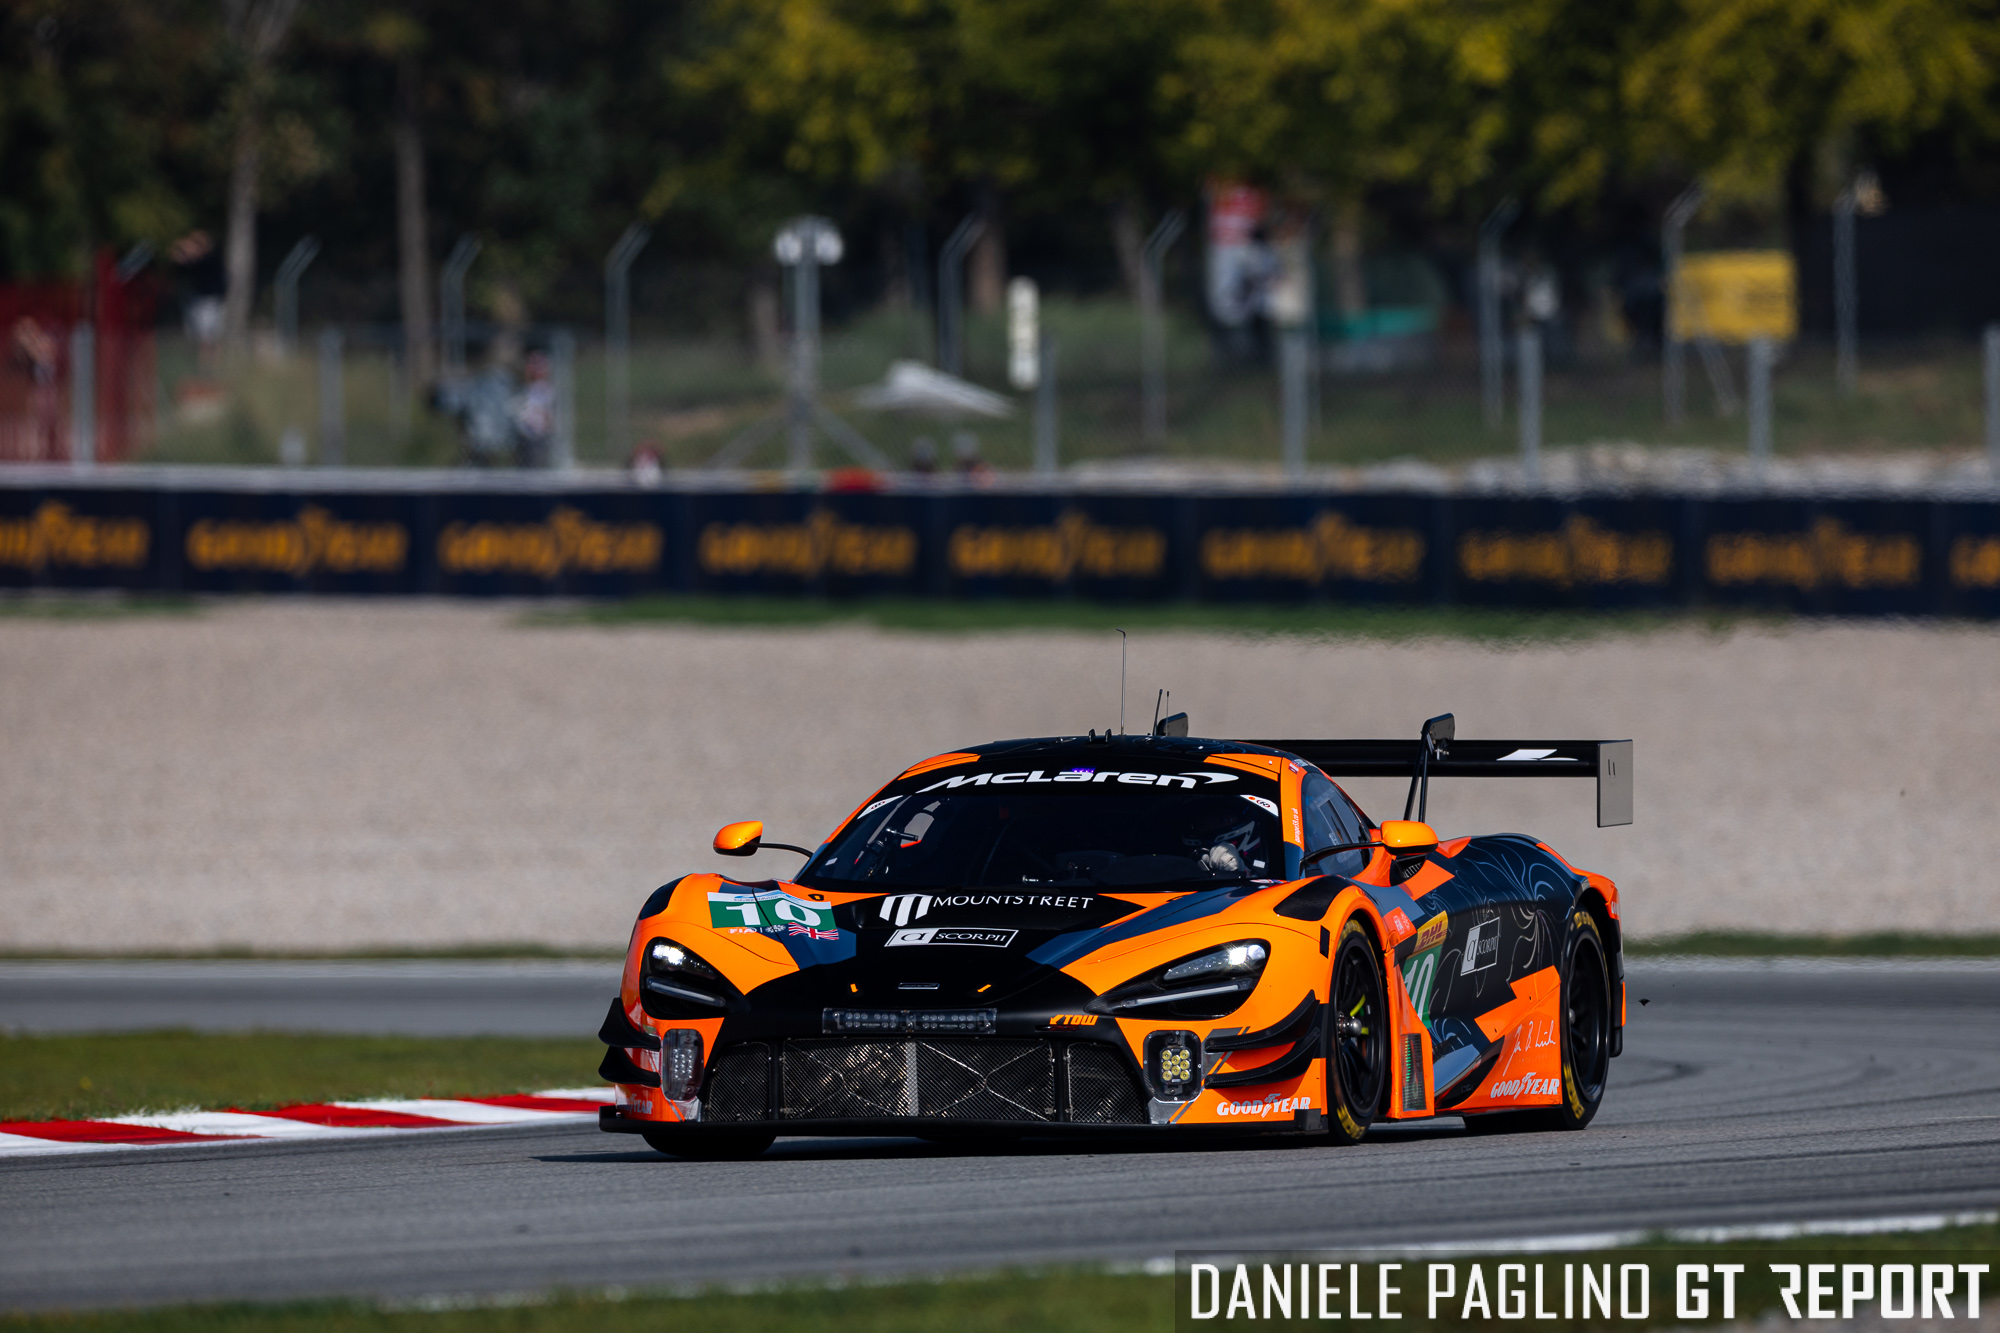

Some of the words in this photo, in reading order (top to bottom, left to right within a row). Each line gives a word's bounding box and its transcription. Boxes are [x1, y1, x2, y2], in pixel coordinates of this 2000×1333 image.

[933, 895, 1094, 909] MOUNTSTREET
[726, 899, 821, 926] 10
[1404, 953, 1435, 1021] 10
[1063, 1014, 1099, 1026] TOW
